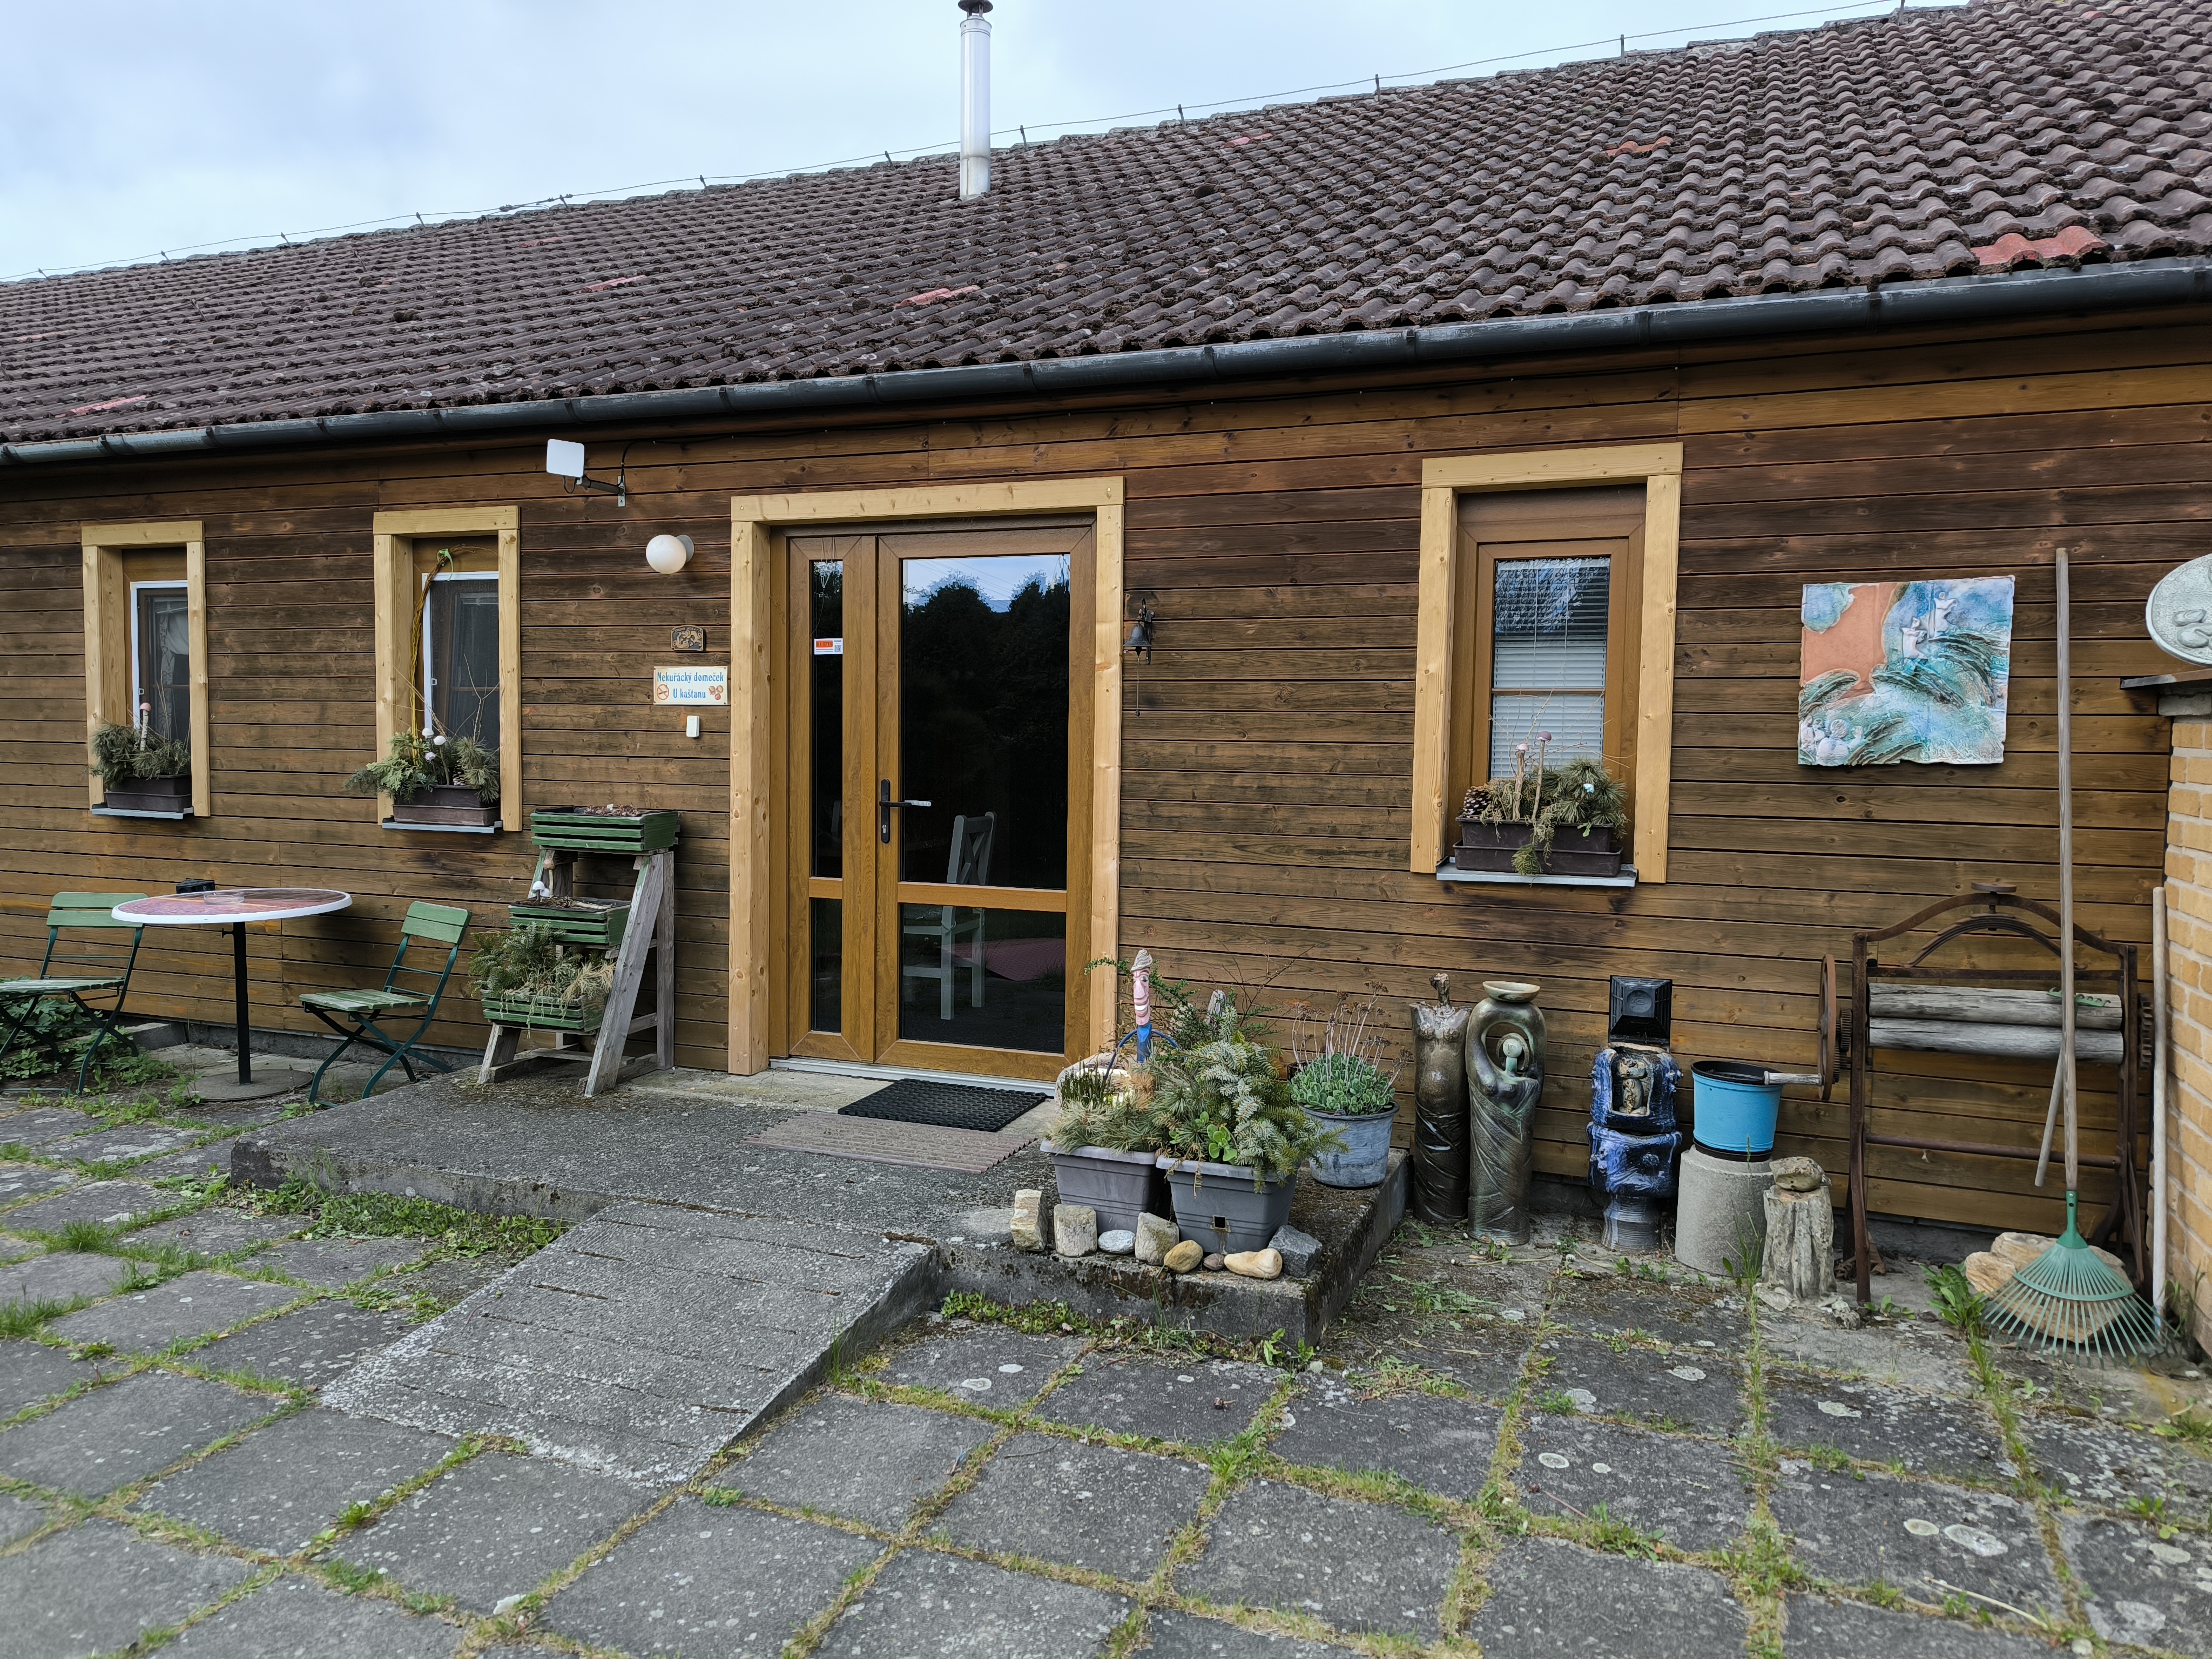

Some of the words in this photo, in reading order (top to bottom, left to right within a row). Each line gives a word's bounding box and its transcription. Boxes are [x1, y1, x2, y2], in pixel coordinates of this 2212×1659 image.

[657, 672, 692, 683] Nekuřácký
[694, 672, 724, 682] domeček
[673, 688, 678, 698] U
[680, 689, 706, 698] kaštanu
